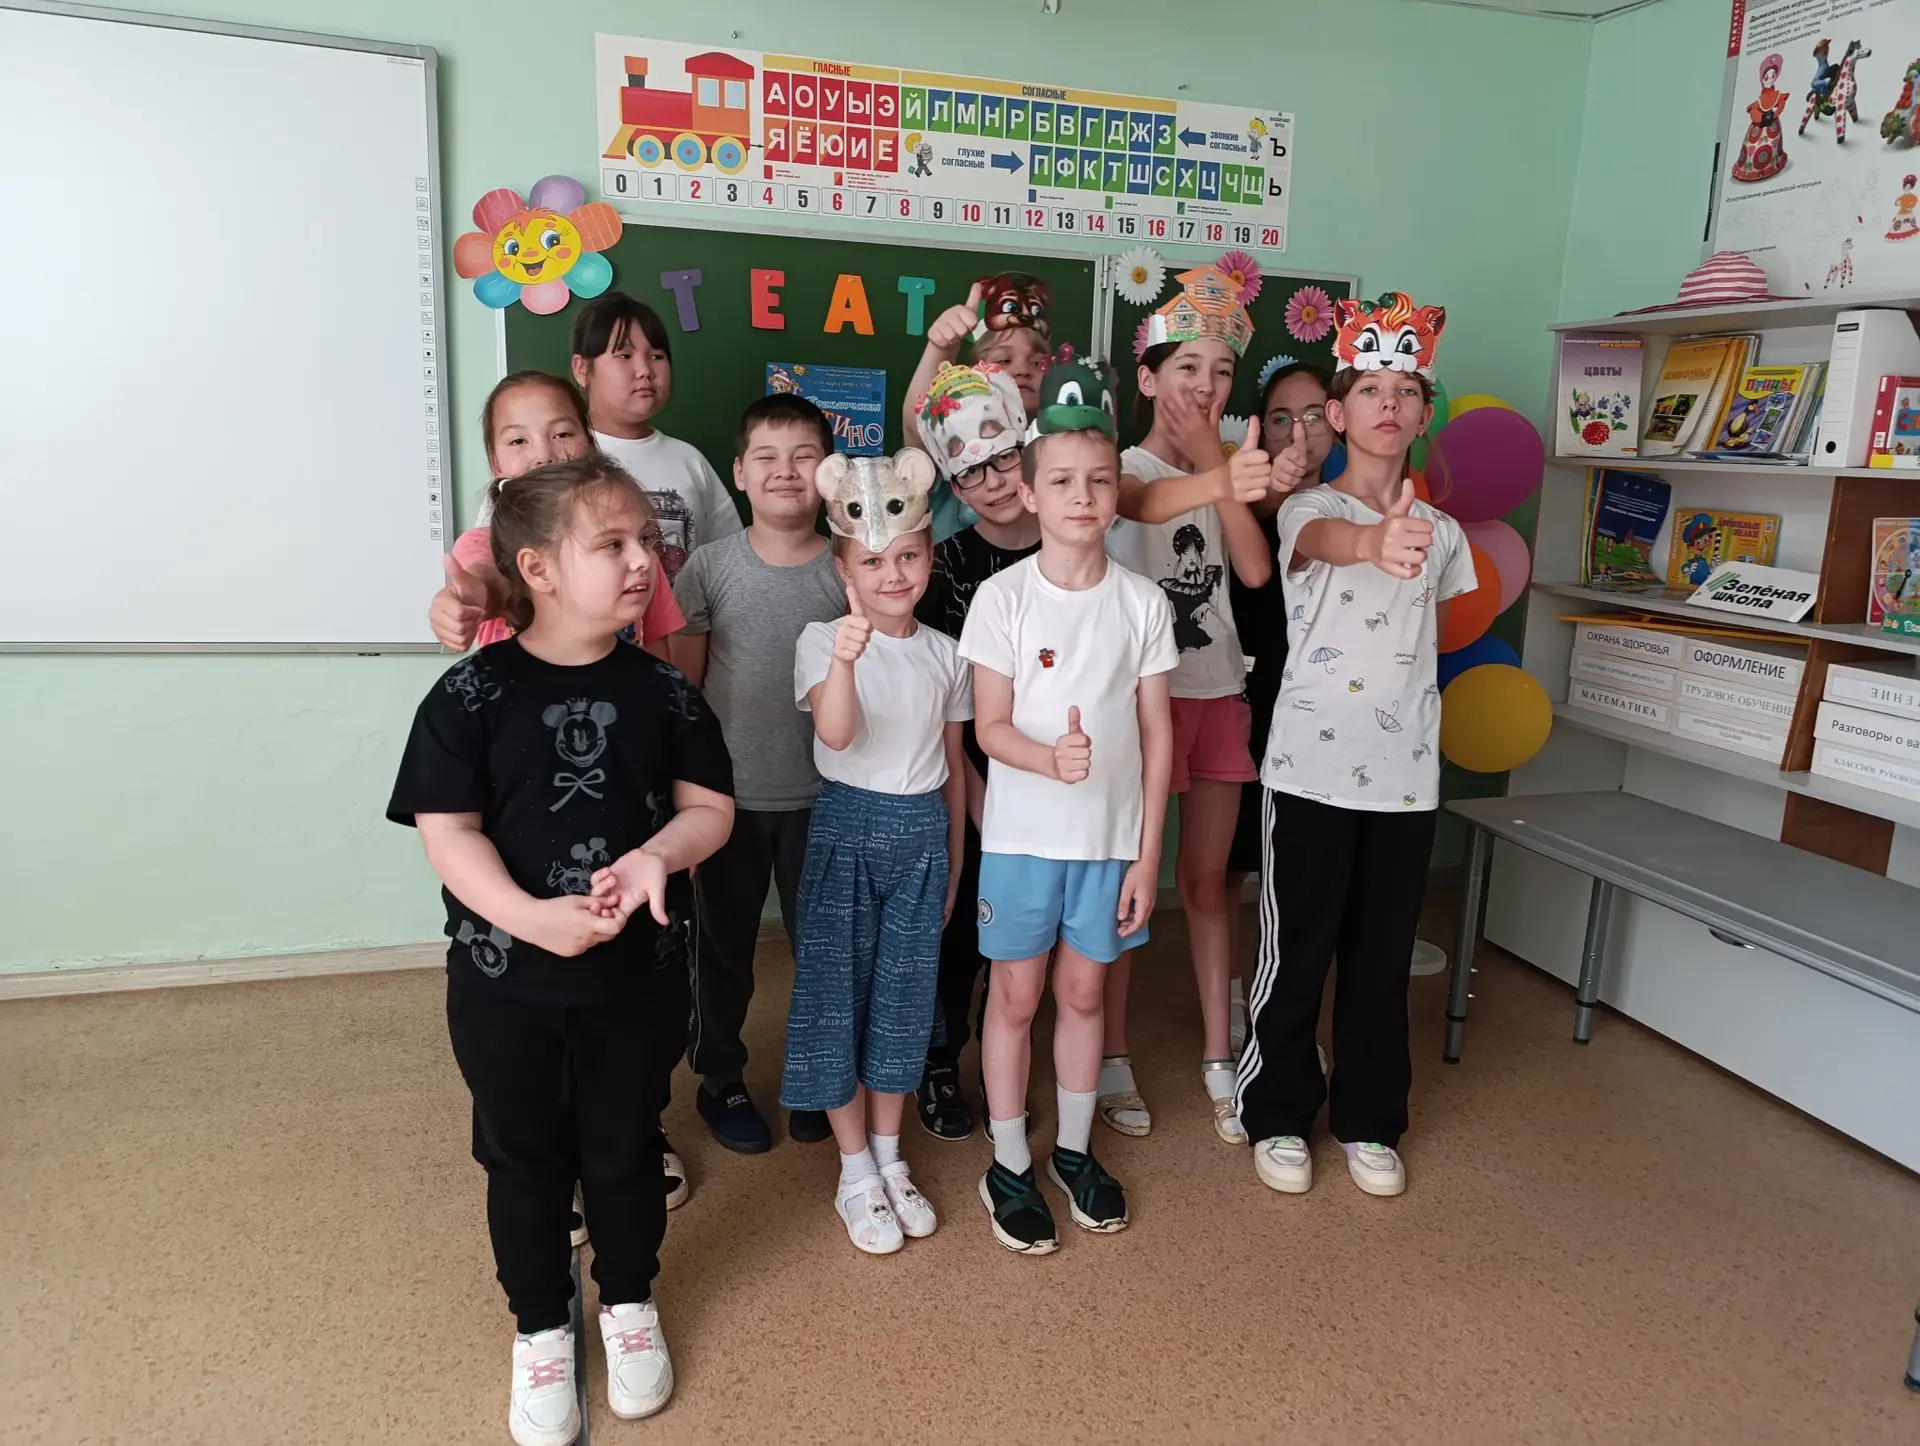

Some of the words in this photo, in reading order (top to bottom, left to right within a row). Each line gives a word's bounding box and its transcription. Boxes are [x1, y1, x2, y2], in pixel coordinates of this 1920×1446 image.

[813, 61, 851, 76] ГЛАСНЫЕ
[767, 82, 786, 105] А
[795, 85, 814, 108] О
[824, 88, 840, 111] У
[848, 92, 870, 115] Ы
[878, 95, 894, 117] Э
[1022, 85, 1067, 100] СОГЛАСНЫЕ
[905, 92, 921, 120] Й
[932, 100, 948, 122] Л
[957, 103, 976, 125] М
[985, 106, 999, 128] Н
[1010, 109, 1025, 130] Р
[1035, 111, 1050, 133] Б
[1060, 114, 1075, 136] В
[1085, 117, 1099, 138] Г
[1108, 120, 1125, 144] Д
[1130, 122, 1151, 143] Ж
[1158, 124, 1171, 145] З
[768, 128, 785, 151] Я
[796, 125, 812, 154] Ё
[820, 133, 844, 156] Ю
[851, 137, 867, 159] И
[878, 139, 893, 161] Е
[1209, 131, 1239, 142] звонкие
[957, 147, 985, 158] глухие
[1209, 142, 1247, 152] согласные
[1269, 137, 1287, 157] Ъ
[941, 157, 985, 169] согласные
[1034, 154, 1049, 176] П
[1056, 157, 1075, 178] Ф
[1083, 159, 1098, 180] К
[1108, 161, 1122, 182] Т
[1128, 163, 1149, 185] Ш
[1155, 165, 1171, 186] С
[1178, 167, 1194, 189] Х
[1201, 170, 1216, 195] Ц
[1225, 172, 1239, 193] Ч
[1243, 174, 1263, 199] Щ
[1269, 177, 1283, 197] Ь
[615, 173, 627, 193] 0
[654, 177, 662, 196] 1
[690, 180, 701, 199] 2
[727, 183, 738, 202] 3
[762, 186, 773, 205] 4
[798, 190, 809, 208] 5
[832, 192, 843, 211] 6
[866, 195, 877, 213] 7
[900, 198, 910, 216] 8
[933, 201, 943, 219] 9
[962, 204, 981, 222] 10
[994, 206, 1010, 225] 11
[1026, 209, 1044, 227] 12
[1056, 211, 1074, 230] 13
[1087, 214, 1105, 232] 14
[1117, 217, 1135, 235] 15
[1148, 219, 1165, 237] 16
[1178, 221, 1195, 239] 17
[1206, 224, 1223, 242] 18
[1234, 226, 1251, 244] 19
[1261, 228, 1279, 246] 20
[1584, 366, 1622, 377] ЦВЕТЫ
[1744, 376, 1797, 393] ПТИЦЫ
[1710, 591, 1773, 609] школа
[1722, 579, 1811, 603] Зелёная
[1587, 631, 1620, 645] ОХРАНА
[1622, 638, 1669, 655] ЗДОРОВЬЯ
[1694, 649, 1786, 679] ОФОРМЛЕНИЕ
[1581, 689, 1657, 717] МАТЕМАТИКА
[1684, 683, 1736, 704] ТРУДОВОЕ
[1737, 695, 1794, 716] ОБУЧЕНИЕ
[1831, 719, 1892, 743] Разговоры
[1895, 736, 1903, 745] о
[1906, 739, 1920, 749] ва
[929, 1067, 952, 1075] FASHION
